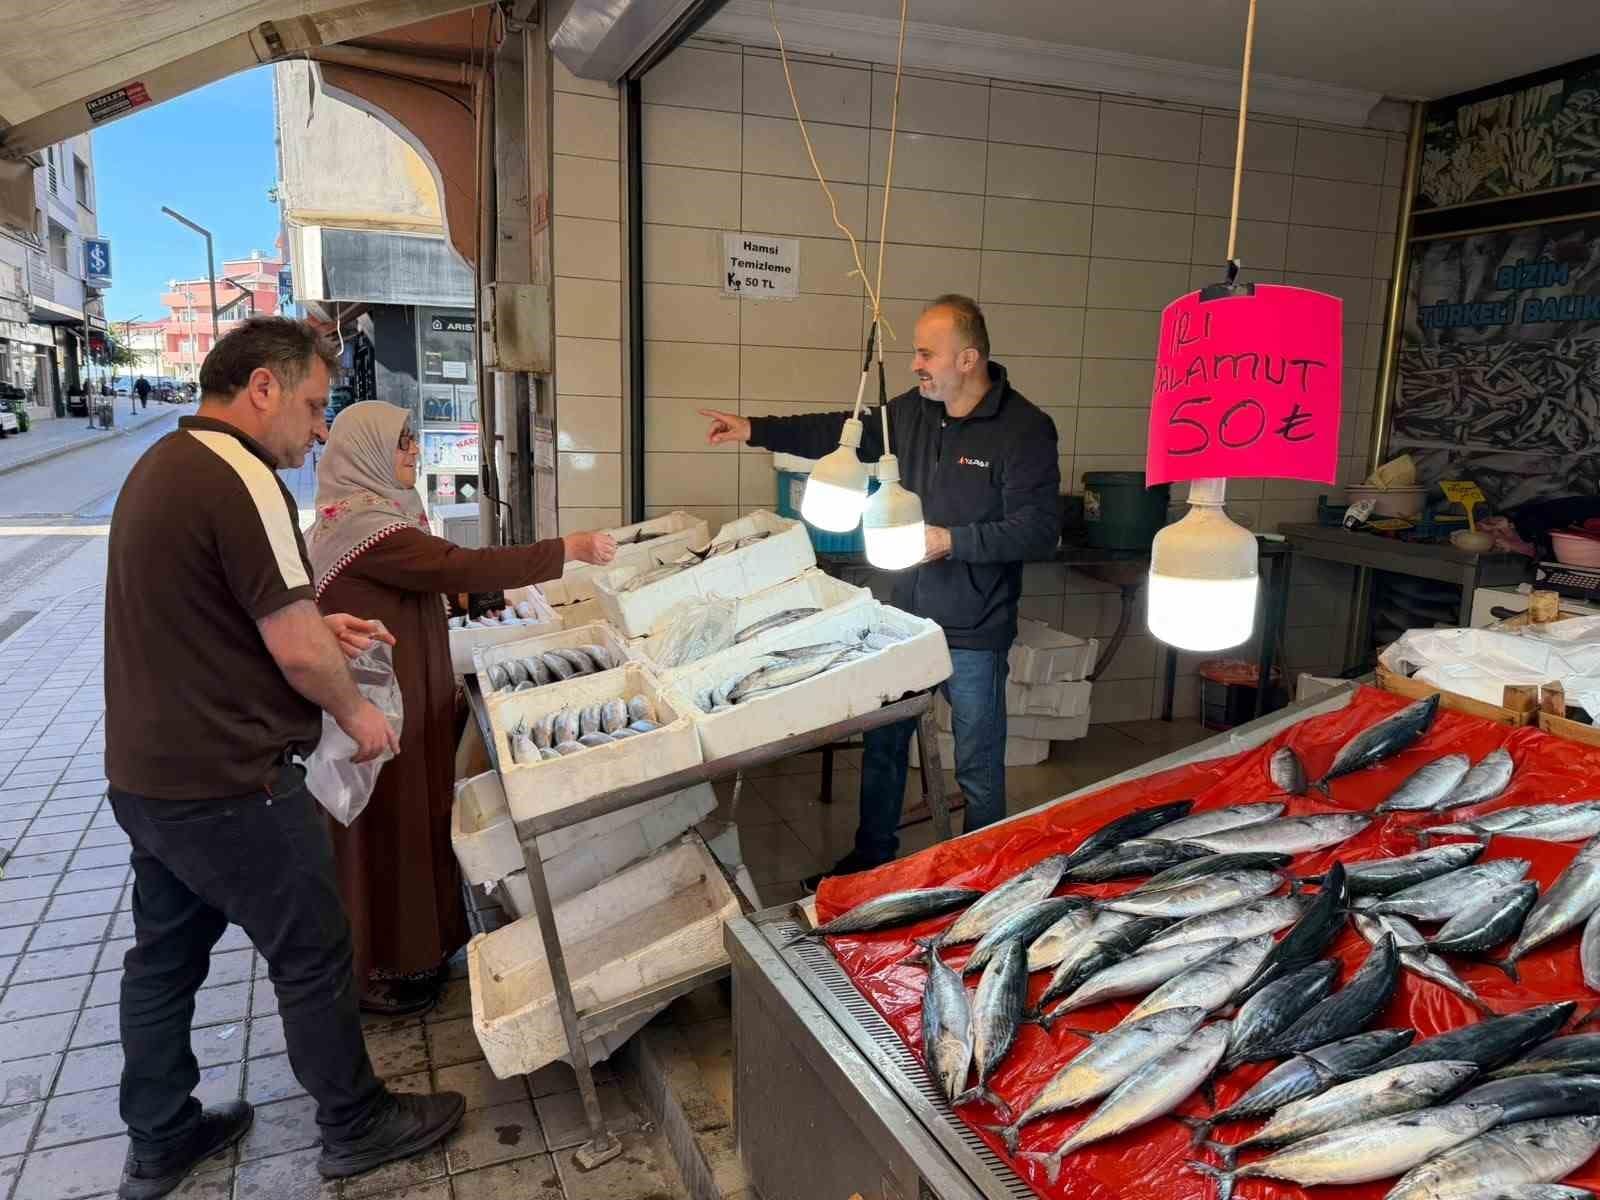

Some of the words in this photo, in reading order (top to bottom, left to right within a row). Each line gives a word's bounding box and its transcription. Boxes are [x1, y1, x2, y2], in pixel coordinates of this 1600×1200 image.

[744, 241, 779, 255] Hamsi
[730, 257, 792, 274] Temizleme
[1496, 256, 1569, 291] BİZİM
[745, 277, 759, 288] 50
[761, 280, 775, 289] TL
[1418, 293, 1516, 329] TÜRKELİ
